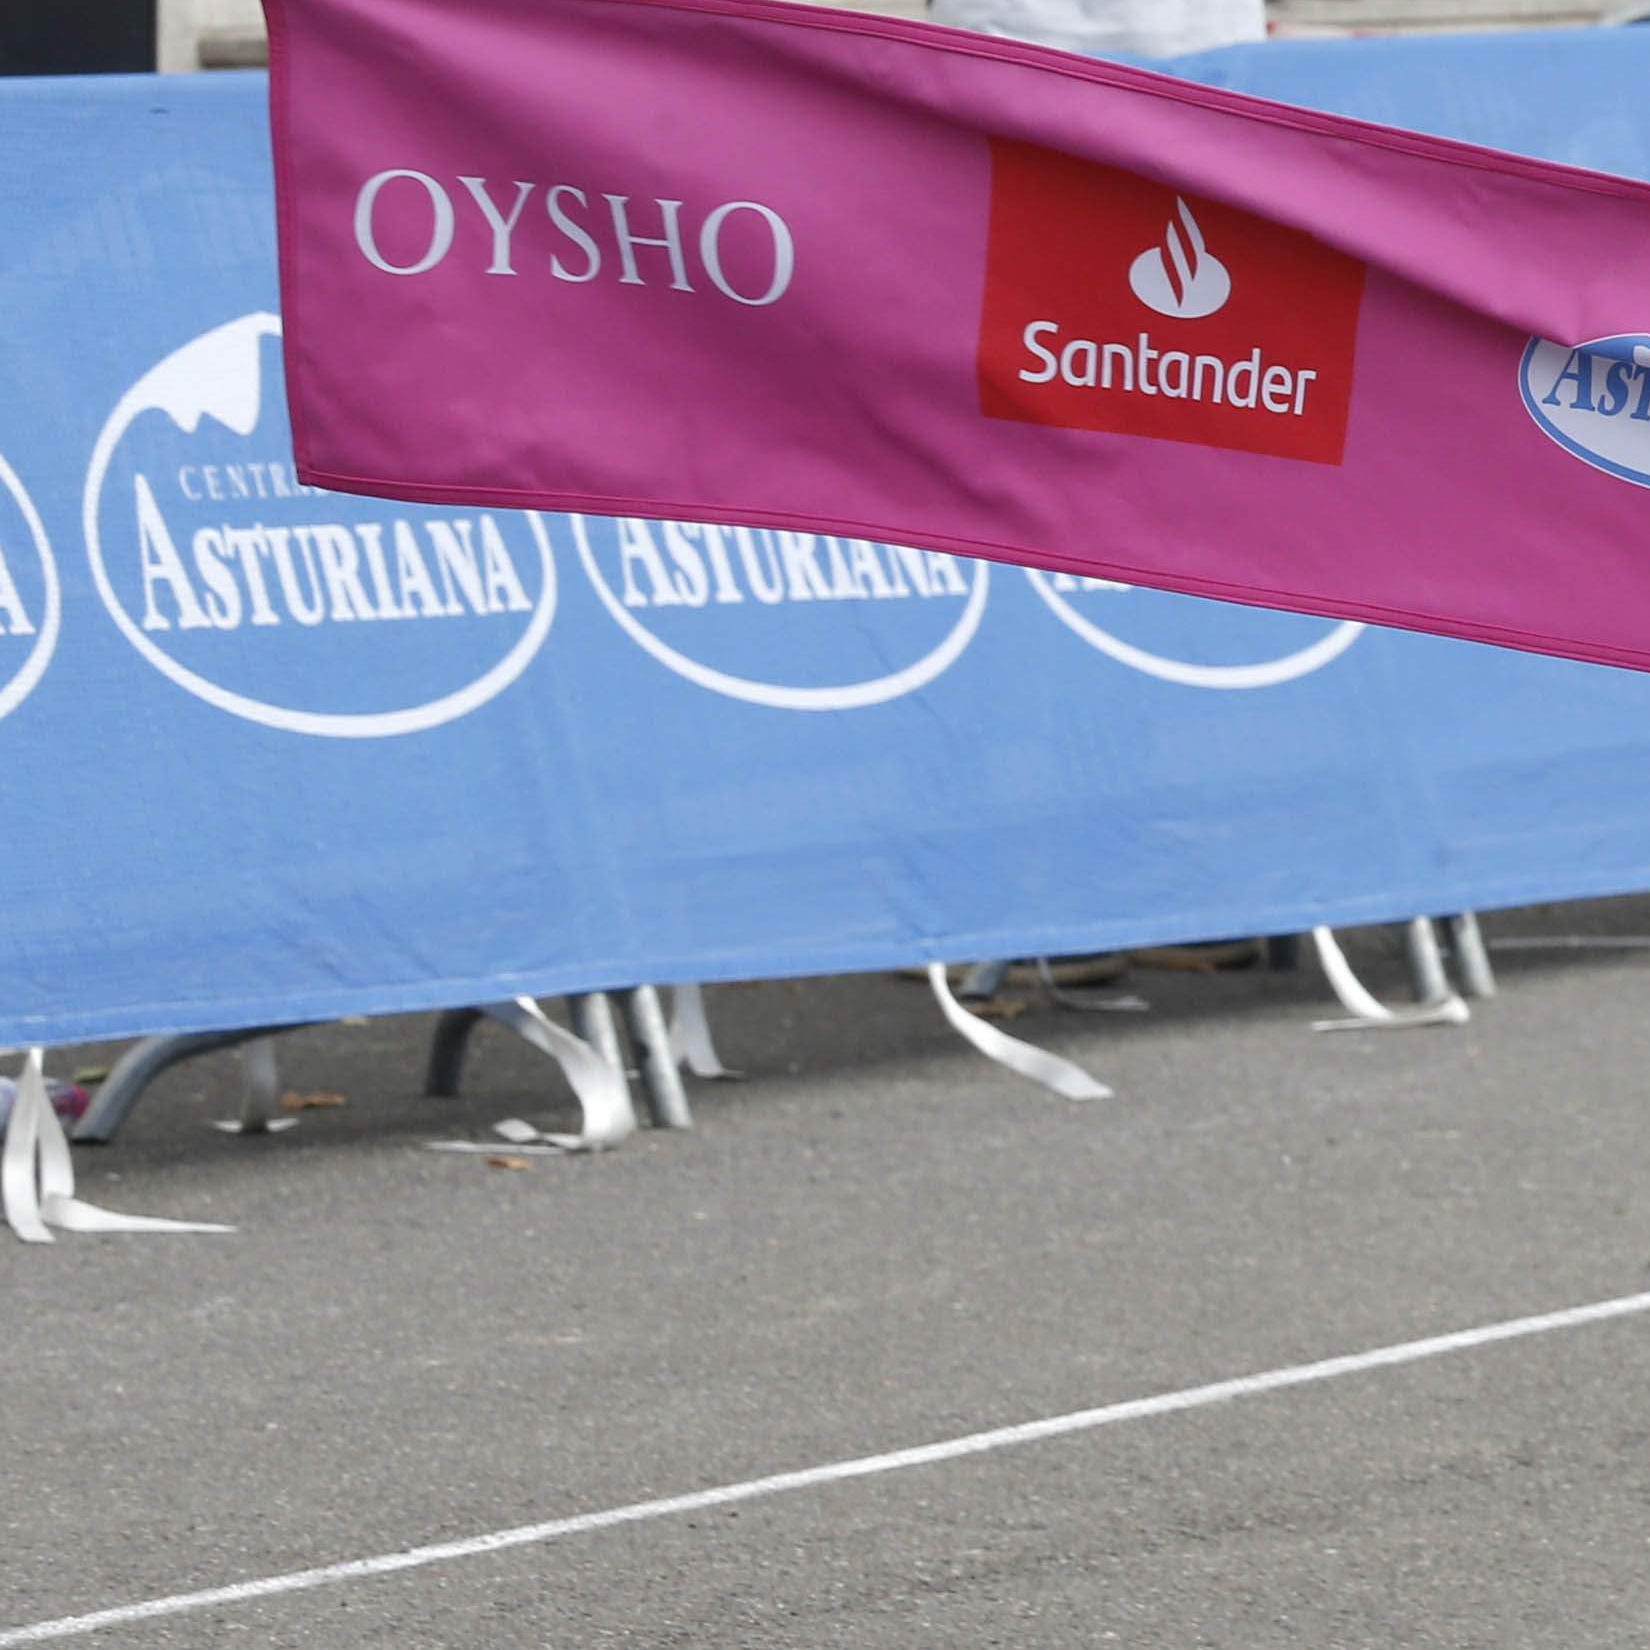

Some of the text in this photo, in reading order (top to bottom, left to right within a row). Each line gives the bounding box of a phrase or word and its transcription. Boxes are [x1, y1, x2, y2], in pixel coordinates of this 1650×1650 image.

[353, 167, 796, 307] OYSHO
[1018, 320, 1318, 416] Santander
[178, 461, 331, 502] CENTR
[134, 472, 534, 631] ASTURIANA
